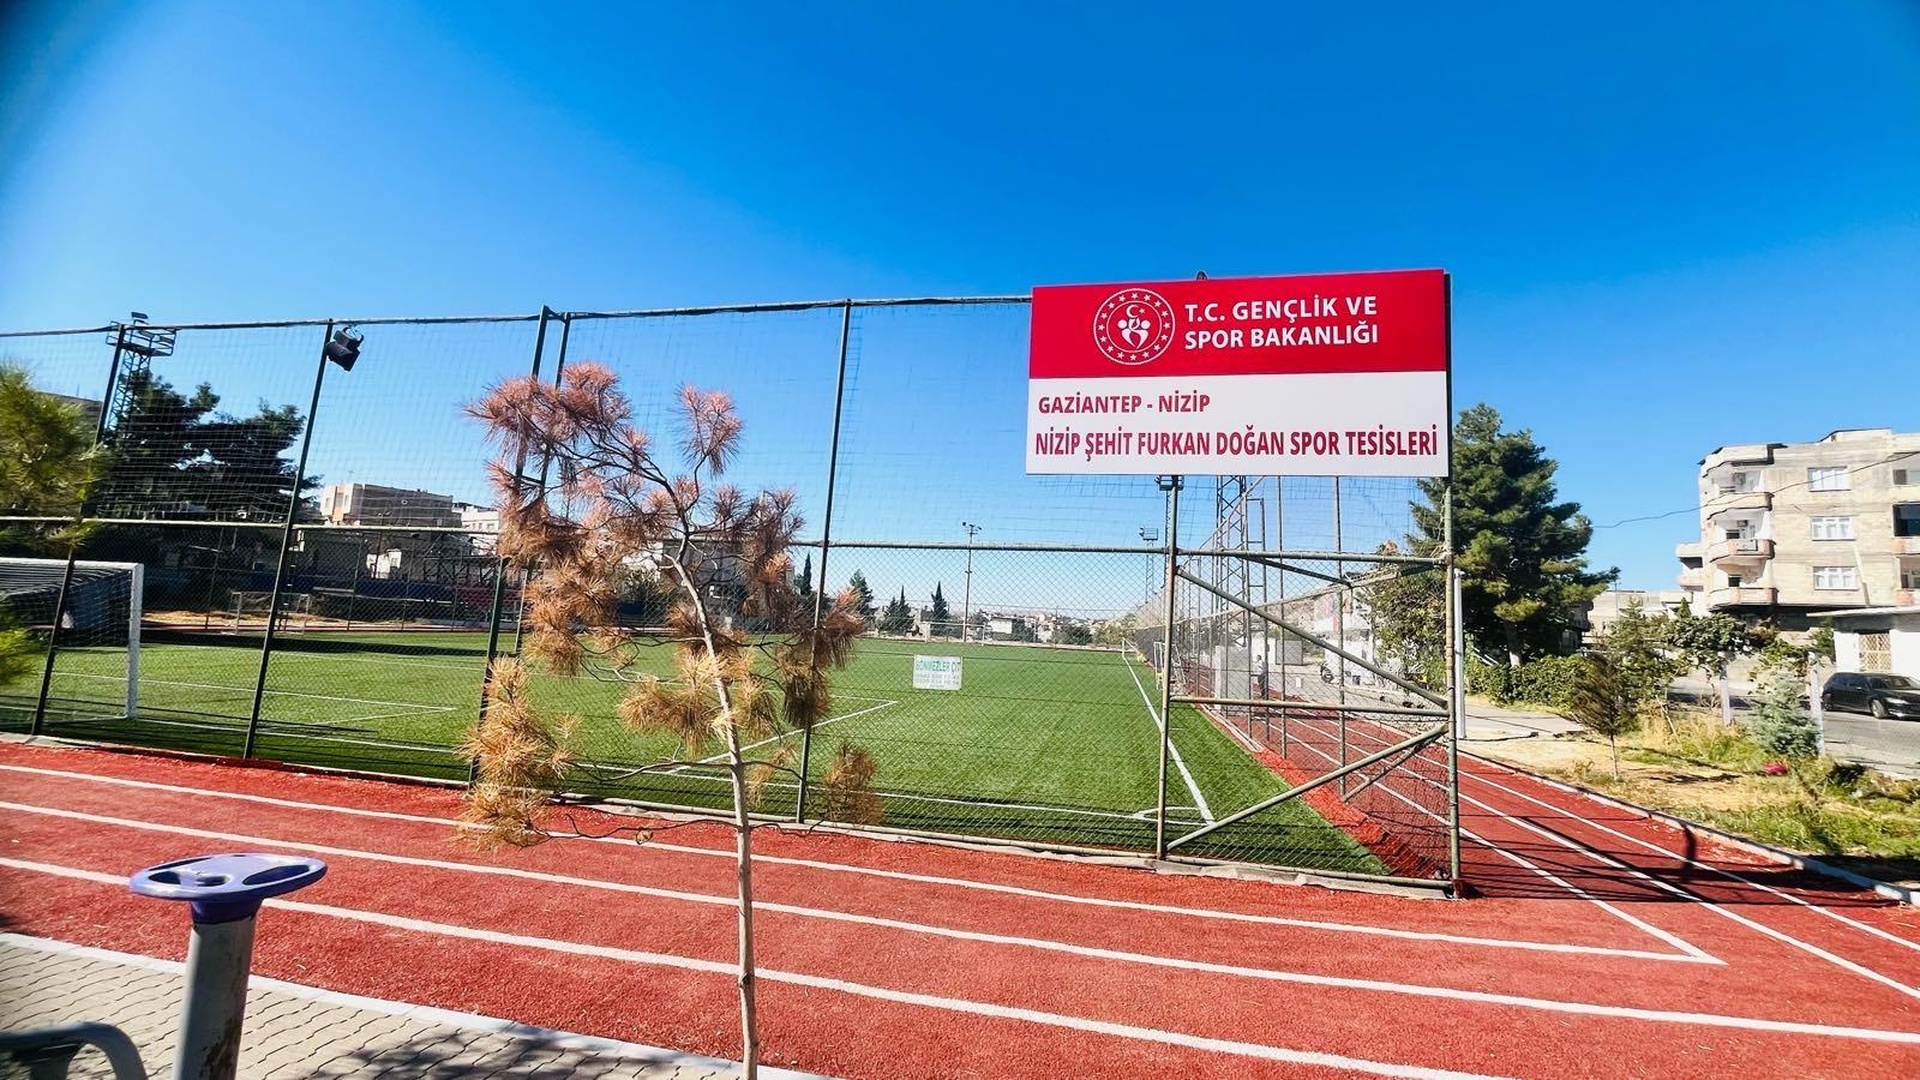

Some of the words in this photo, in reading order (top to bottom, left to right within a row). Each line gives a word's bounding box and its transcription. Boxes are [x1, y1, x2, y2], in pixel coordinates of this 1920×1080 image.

[1185, 303, 1226, 323] T.C.
[1232, 294, 1338, 323] GENÇLİK
[1346, 296, 1378, 316] VE
[1184, 329, 1244, 350] SPOR
[1250, 320, 1379, 348] BAKANLIĞI
[1038, 391, 1142, 414] GAZİANTEP
[1158, 390, 1211, 413] NİZİP
[1035, 426, 1081, 456] NİZİP
[1085, 426, 1133, 462] ŞEHİT
[1138, 432, 1210, 456] FURKAN
[1216, 424, 1284, 456] DOĞAN
[1290, 432, 1341, 456] SPOR
[1345, 424, 1438, 456] TESİSLERİ
